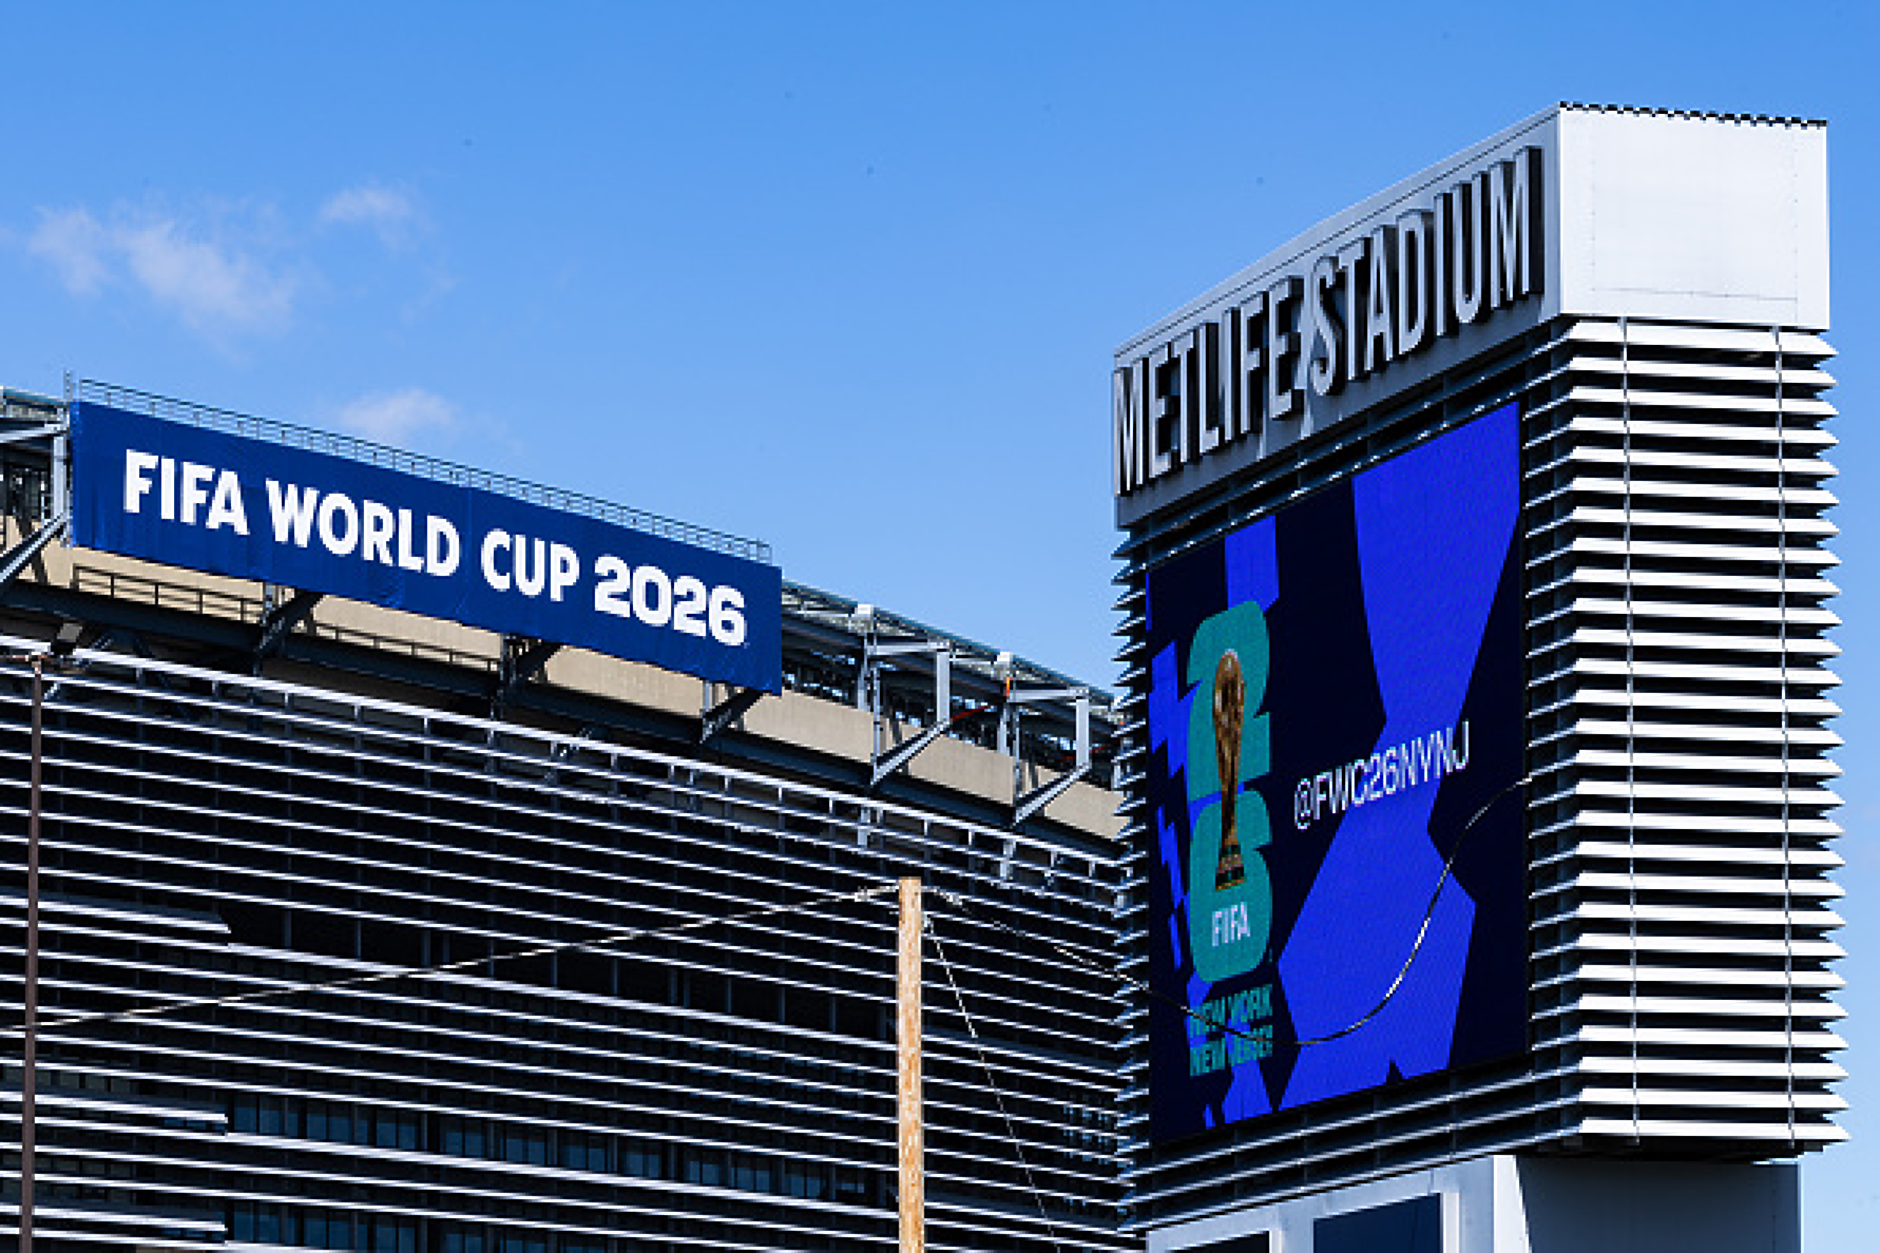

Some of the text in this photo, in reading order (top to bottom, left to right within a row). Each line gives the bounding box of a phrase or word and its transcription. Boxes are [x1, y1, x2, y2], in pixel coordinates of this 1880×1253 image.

[1113, 145, 1544, 498] METLIFE STADIUM
[124, 448, 746, 646] FIFA WORLD CUP 2026
[1212, 901, 1251, 947] FIFA
